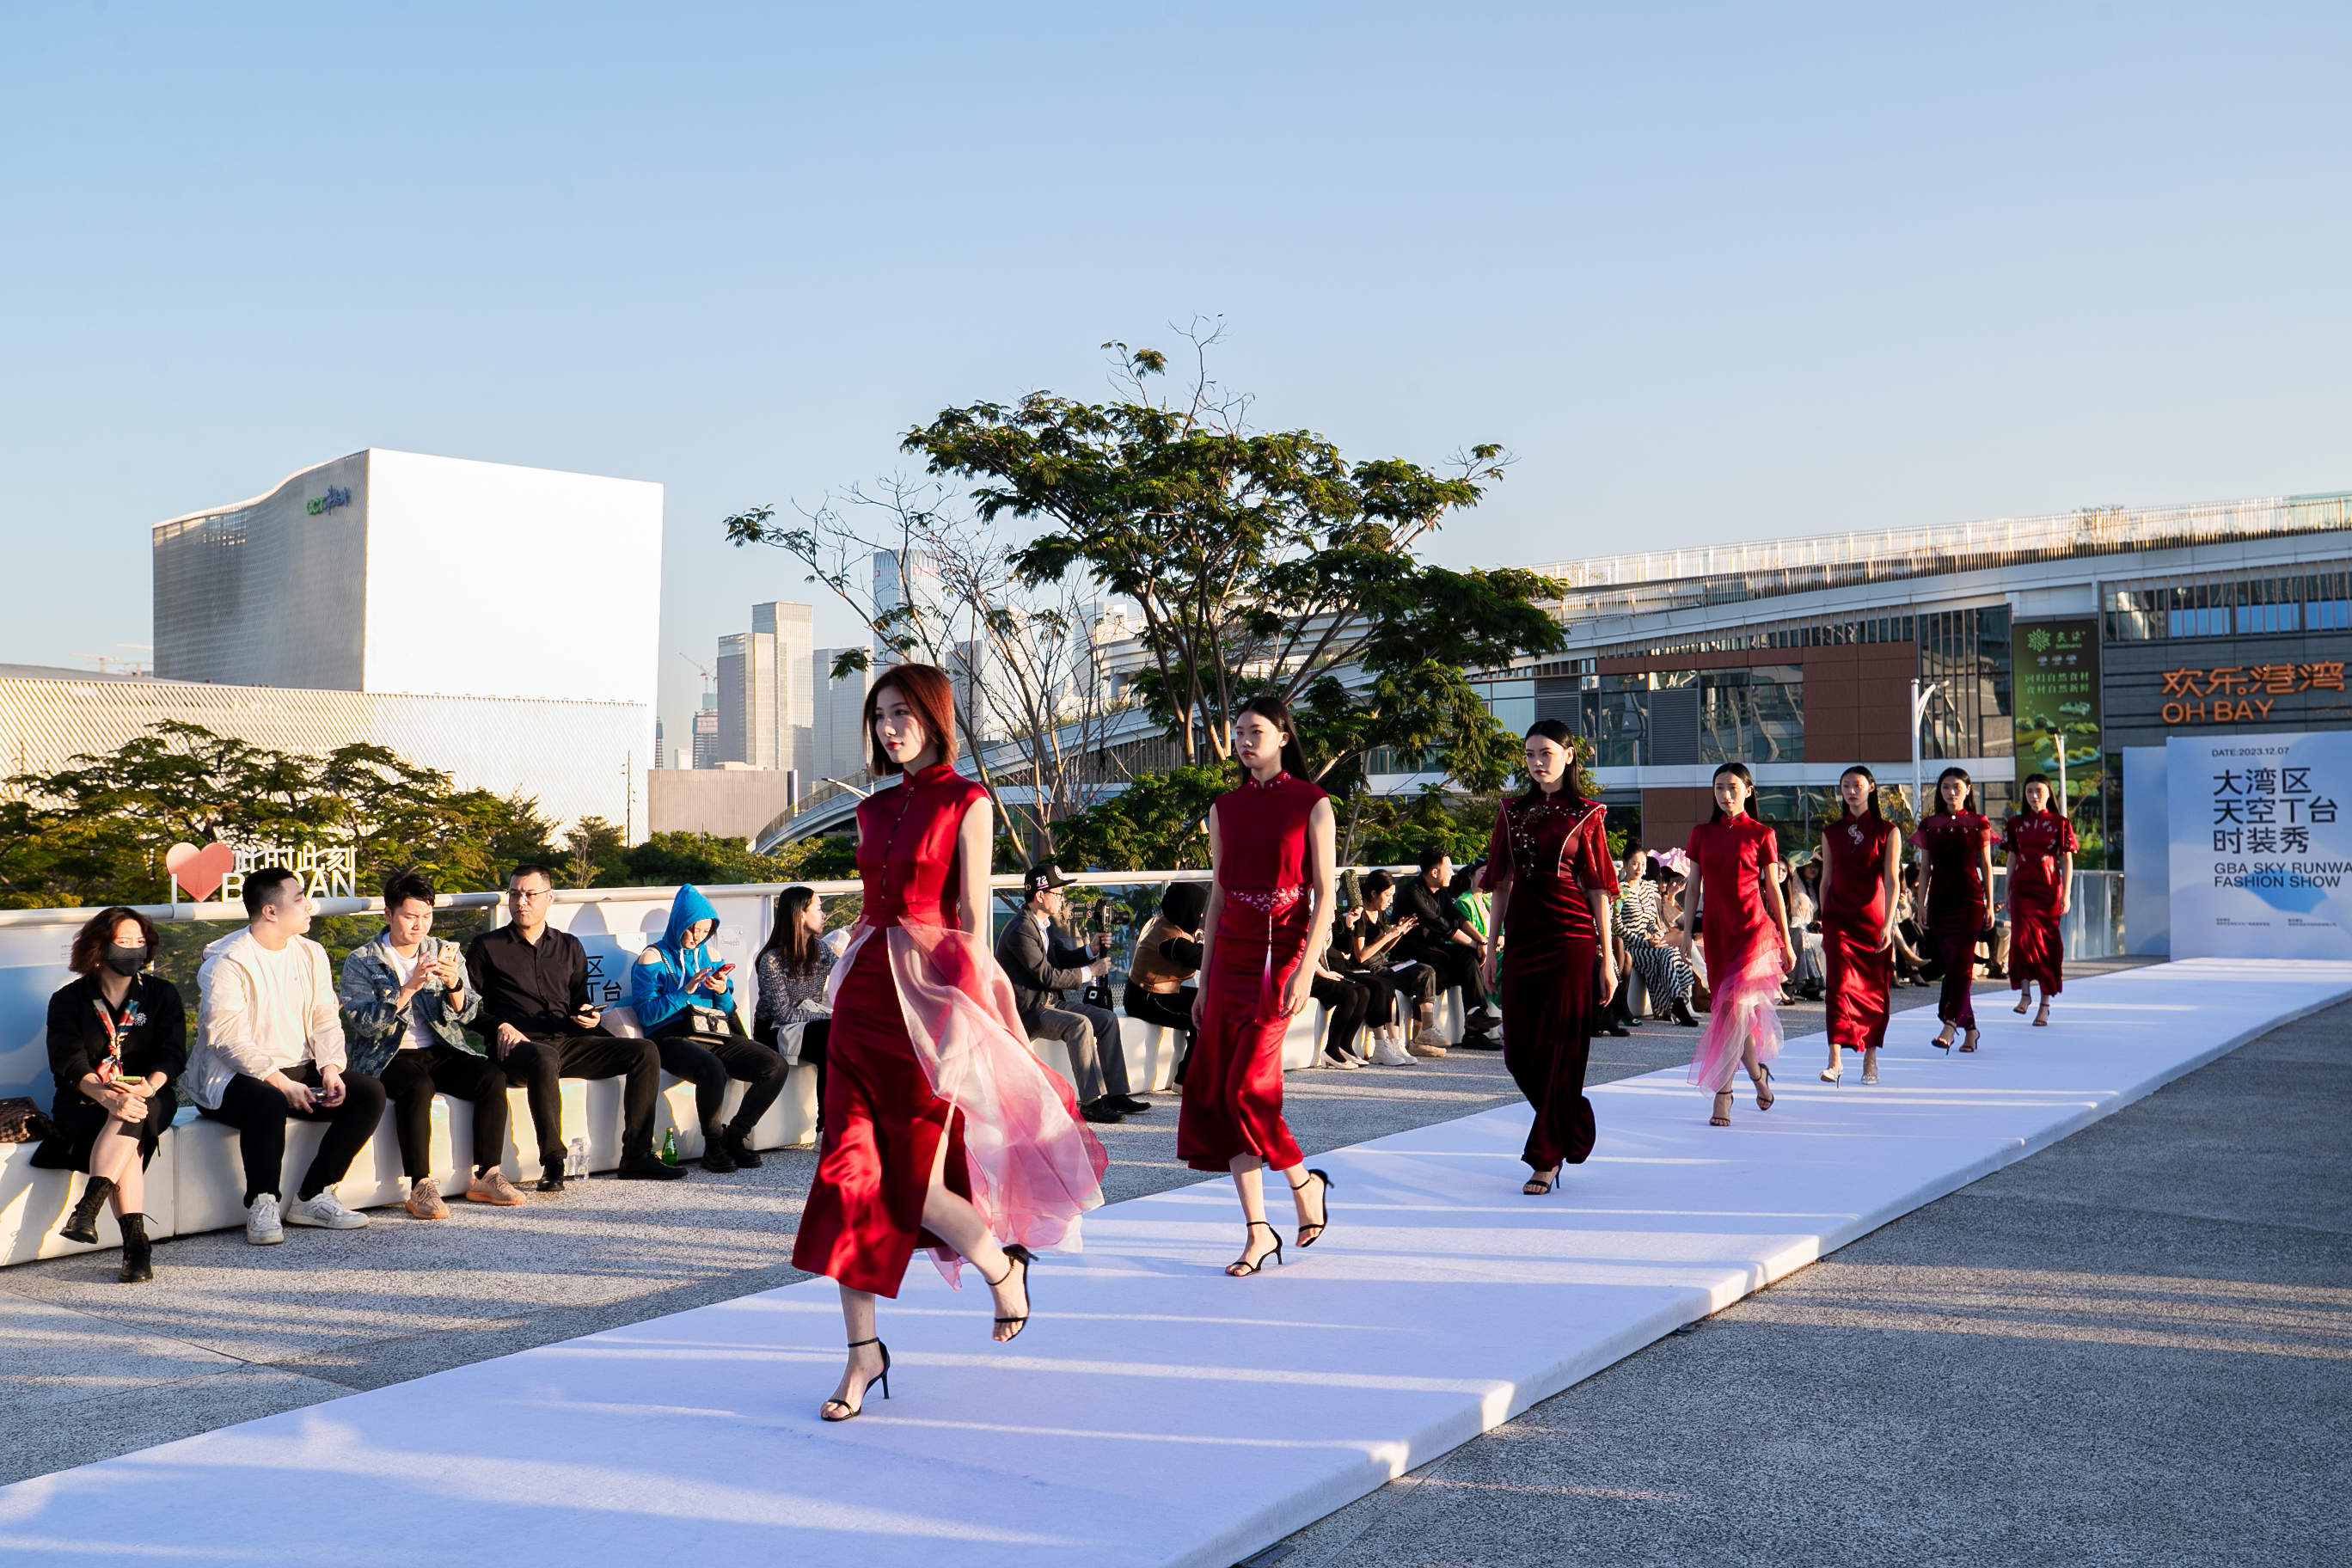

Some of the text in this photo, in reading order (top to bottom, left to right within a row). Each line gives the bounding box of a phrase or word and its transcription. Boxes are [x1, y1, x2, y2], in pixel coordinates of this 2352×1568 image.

[2024, 671, 2089, 683] 回归自然食材
[2027, 683, 2089, 695] 食材自然新鲜
[2161, 660, 2346, 699] 欢乐港湾
[2161, 698, 2275, 723] OH BAY
[2212, 747, 2290, 757] DATE:2023.12.07
[2213, 768, 2312, 796] 大湾区
[2213, 796, 2338, 824] 天空T台
[2213, 826, 2309, 854] 时装秀
[234, 845, 355, 873] 此时此刻
[2214, 862, 2248, 874] GBA
[2254, 862, 2286, 874] SKY
[221, 870, 355, 903] BAN
[1036, 875, 1048, 885] 72
[2214, 875, 2341, 888] FASHION SHOW
